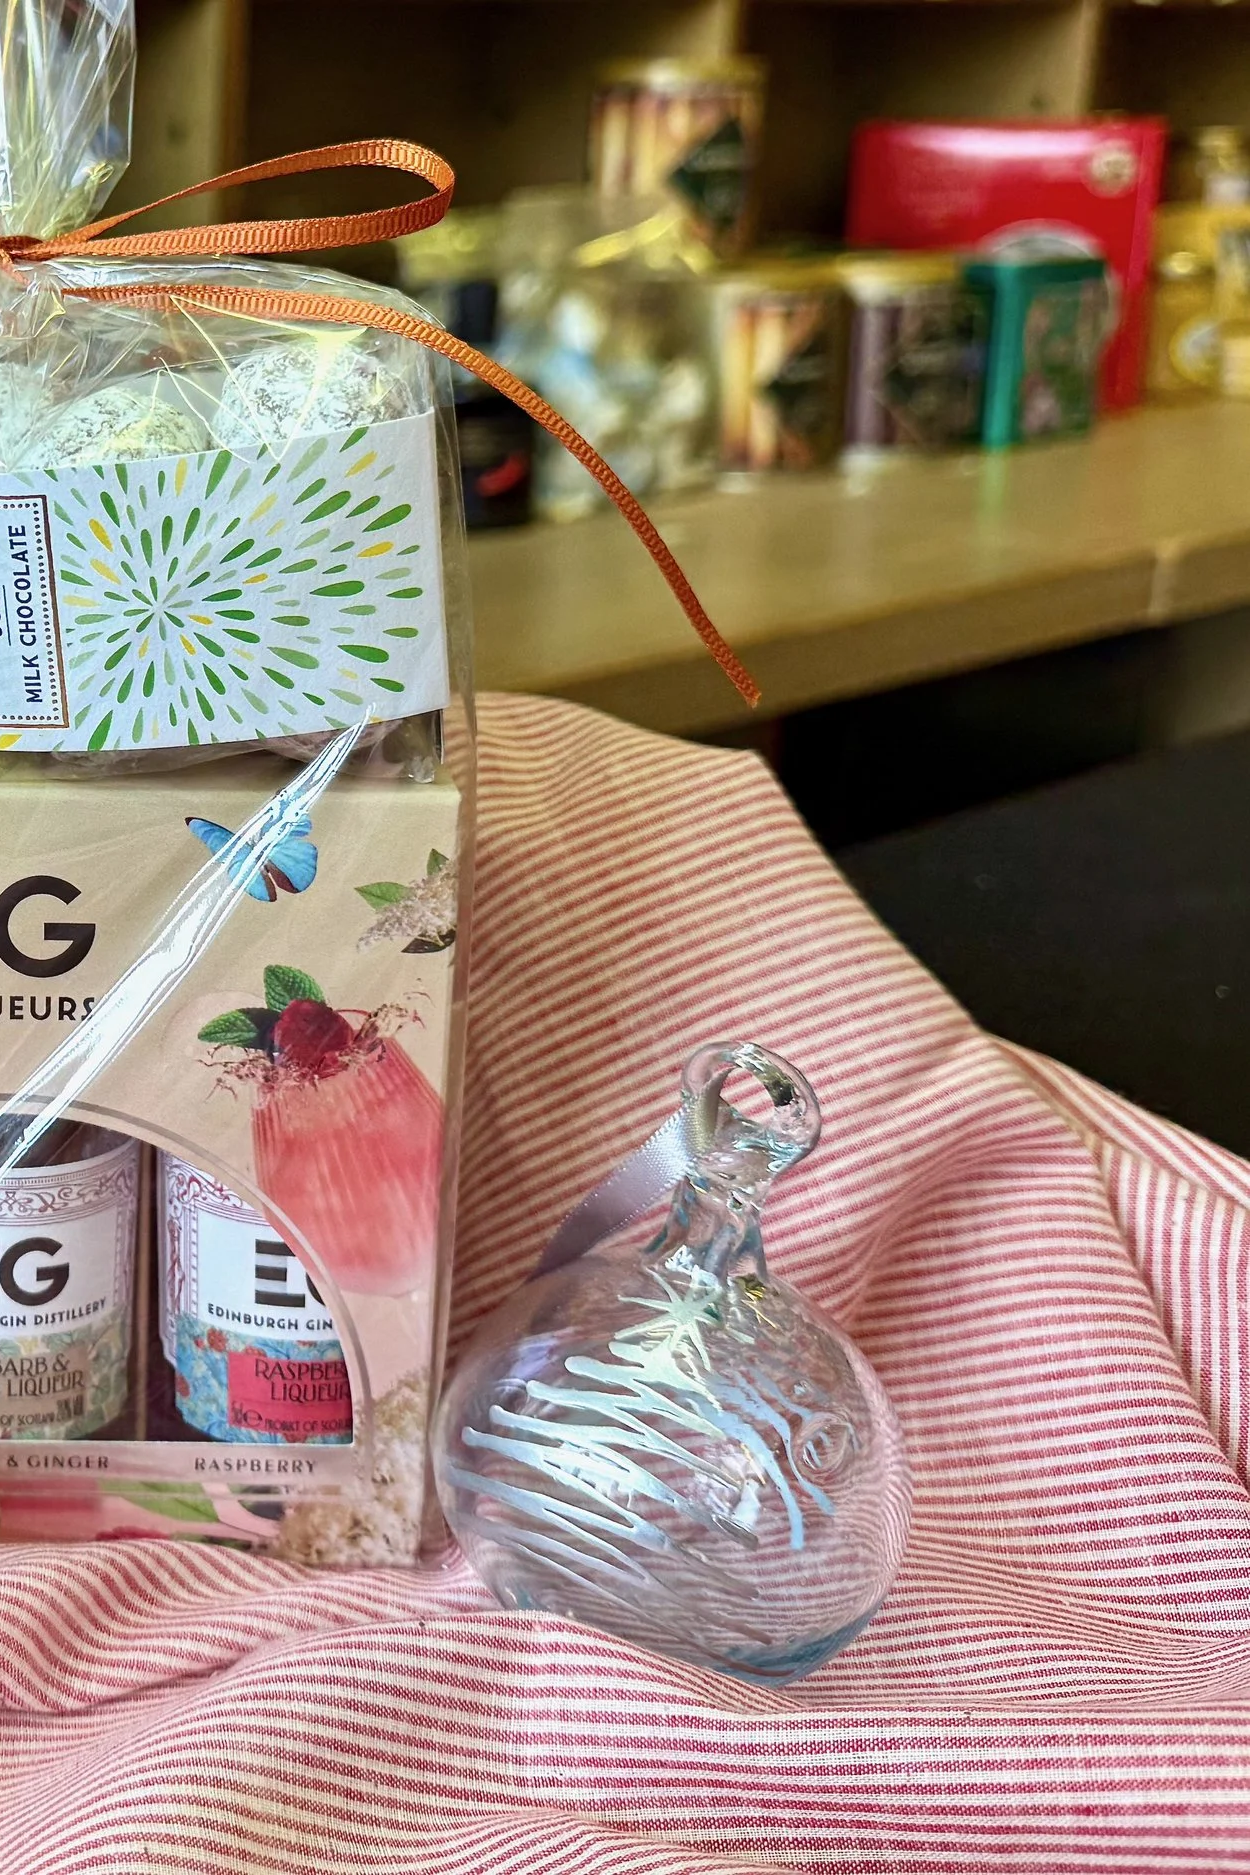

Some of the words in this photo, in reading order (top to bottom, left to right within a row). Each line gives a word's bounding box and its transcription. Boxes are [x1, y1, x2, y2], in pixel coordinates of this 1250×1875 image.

[7, 525, 37, 648] CHOCOLATE
[16, 657, 44, 703] MILK
[0, 1315, 27, 1327] GIN
[34, 1296, 107, 1326] DISTILLERY
[207, 1303, 299, 1331] EDINBURGH
[305, 1318, 334, 1331] GIN
[52, 1353, 71, 1372] &
[7, 1370, 85, 1397] LIQUEUR
[7, 1453, 19, 1468] &
[27, 1453, 110, 1469] GINGER
[194, 1457, 317, 1474] RASPBERRY
